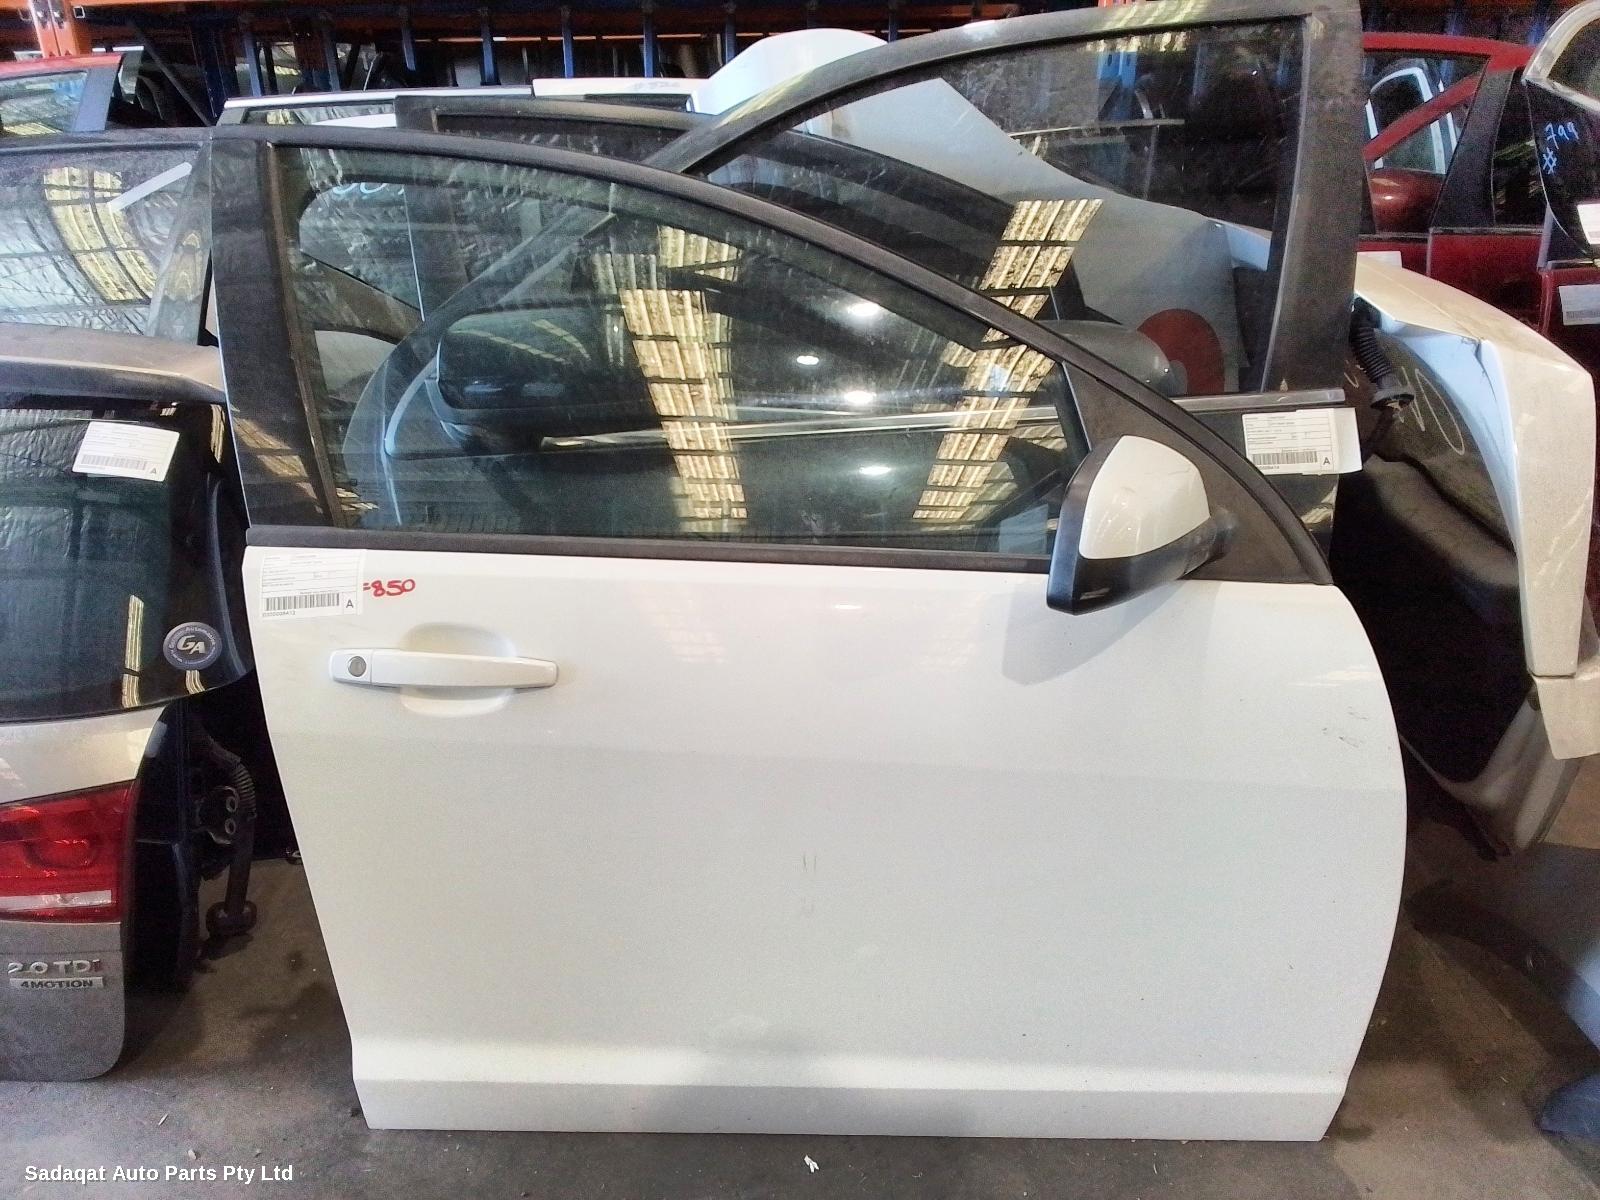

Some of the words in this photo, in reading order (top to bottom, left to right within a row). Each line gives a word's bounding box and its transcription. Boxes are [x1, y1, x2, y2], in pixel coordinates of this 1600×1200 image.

[1323, 457, 1331, 465] A
[345, 599, 354, 608] A
[177, 635, 206, 654] GA
[20, 980, 94, 989] 4MOTION
